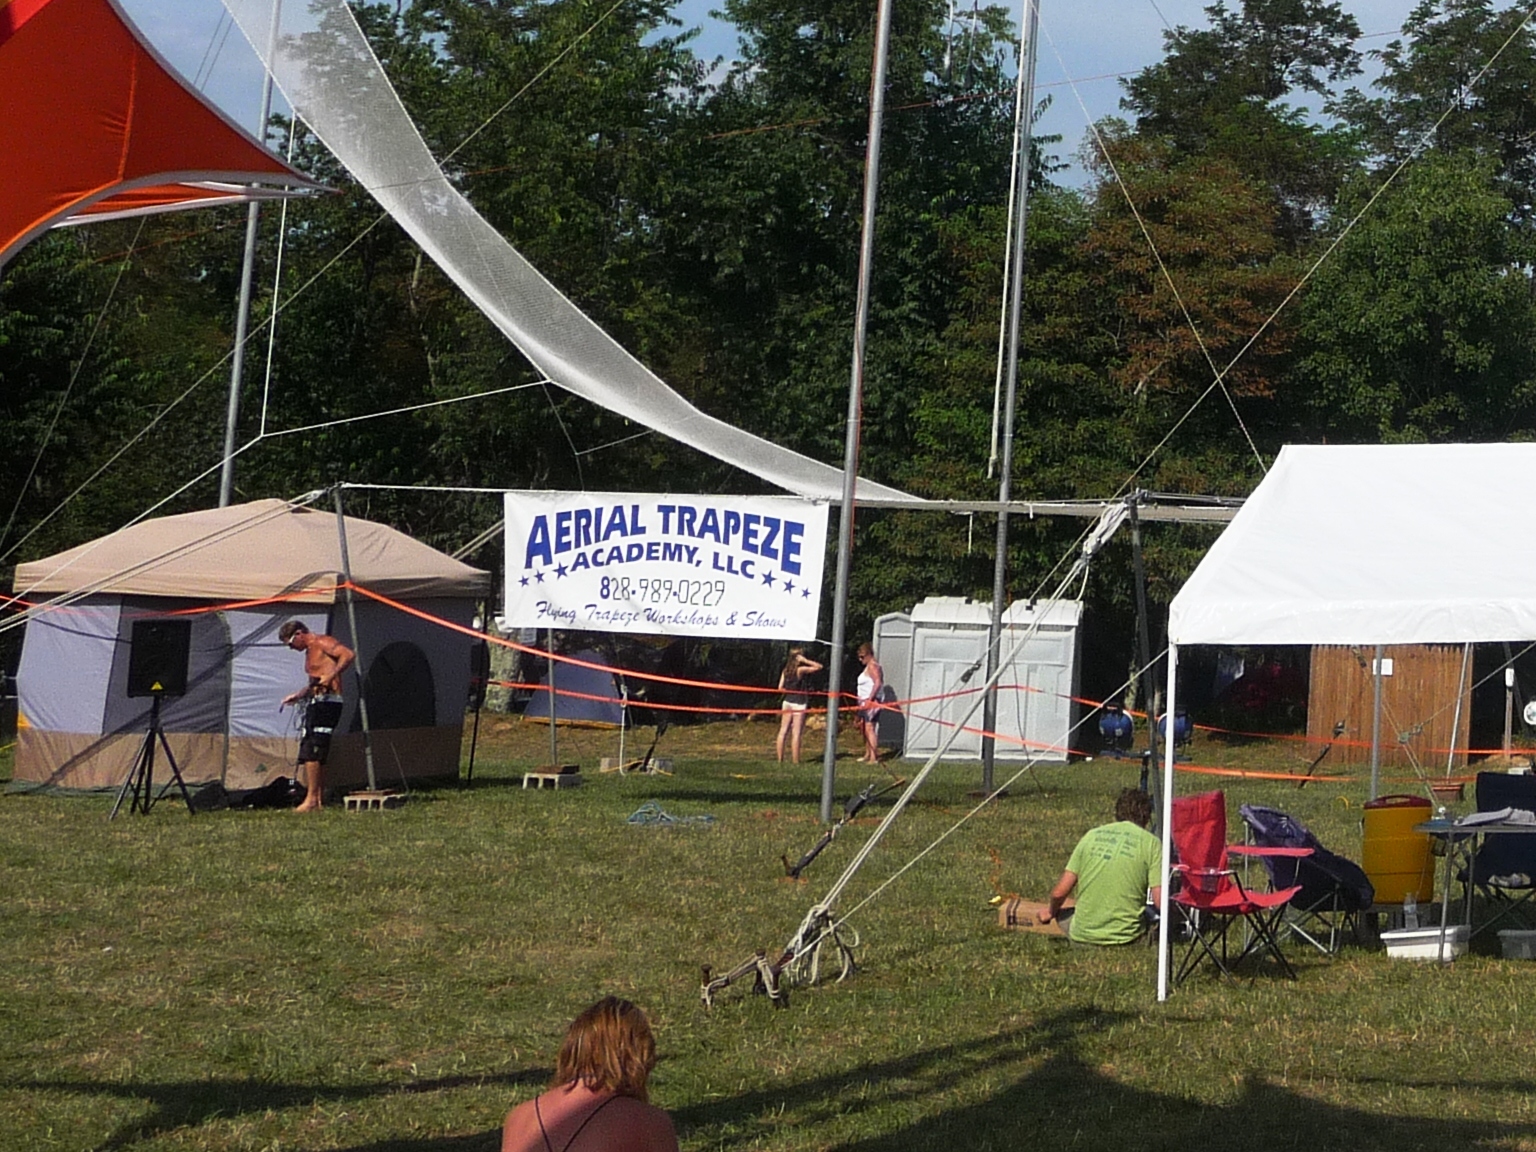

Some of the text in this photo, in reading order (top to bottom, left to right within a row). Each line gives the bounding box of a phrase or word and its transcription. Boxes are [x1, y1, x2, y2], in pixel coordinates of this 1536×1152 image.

[524, 504, 805, 576] AERIAL TRAPEZE
[570, 541, 756, 579] ACADEMY, LLC
[536, 600, 787, 629] Flying Trapeze Workshops & Shows
